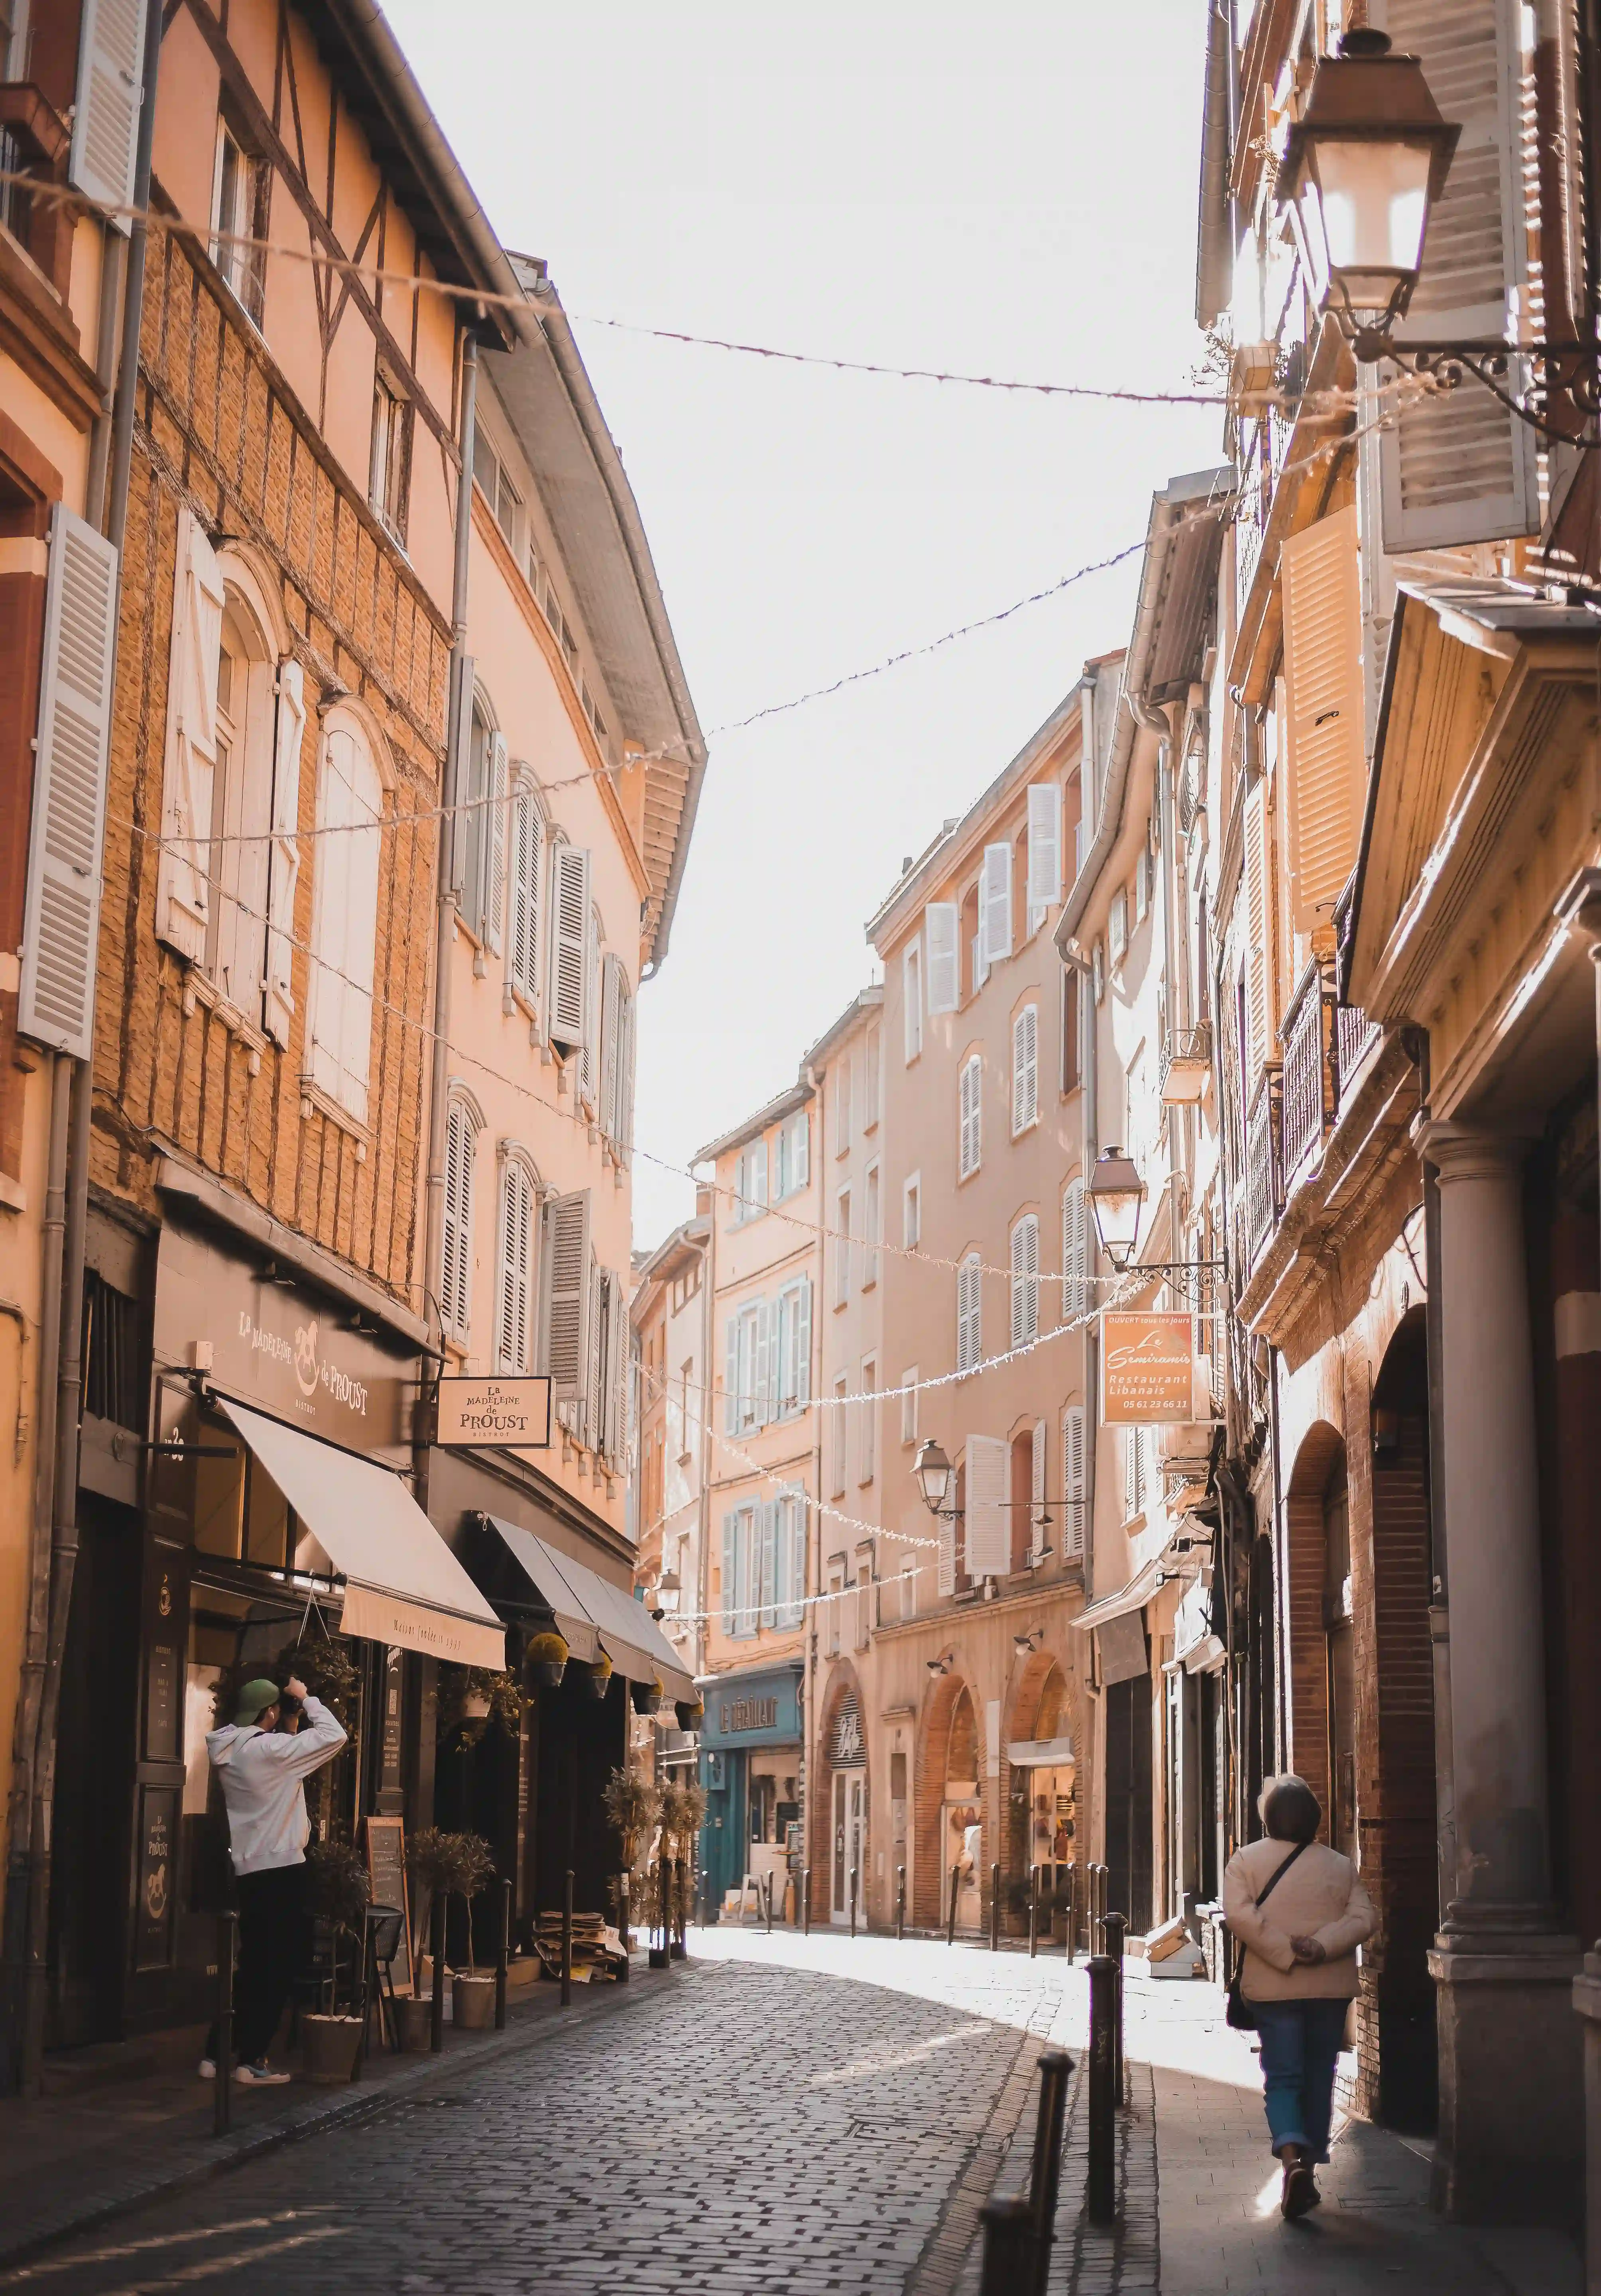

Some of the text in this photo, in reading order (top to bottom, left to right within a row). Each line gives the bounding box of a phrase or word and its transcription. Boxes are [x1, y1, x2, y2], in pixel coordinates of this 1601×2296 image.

[1137, 1330, 1163, 1350] Le
[1107, 1346, 1191, 1369] Semiramis
[1109, 1375, 1188, 1384] Restaurant
[321, 1359, 329, 1387] de
[330, 1365, 368, 1416] PROUST
[1109, 1385, 1165, 1395] Libanais
[295, 1399, 316, 1416] BISTROT
[466, 1396, 520, 1406] MADELEINE
[1123, 1400, 1187, 1408] 05 61 23 66 11
[486, 1405, 497, 1414] de
[460, 1414, 528, 1430] PROUST
[149, 1841, 168, 1856] PROUST
